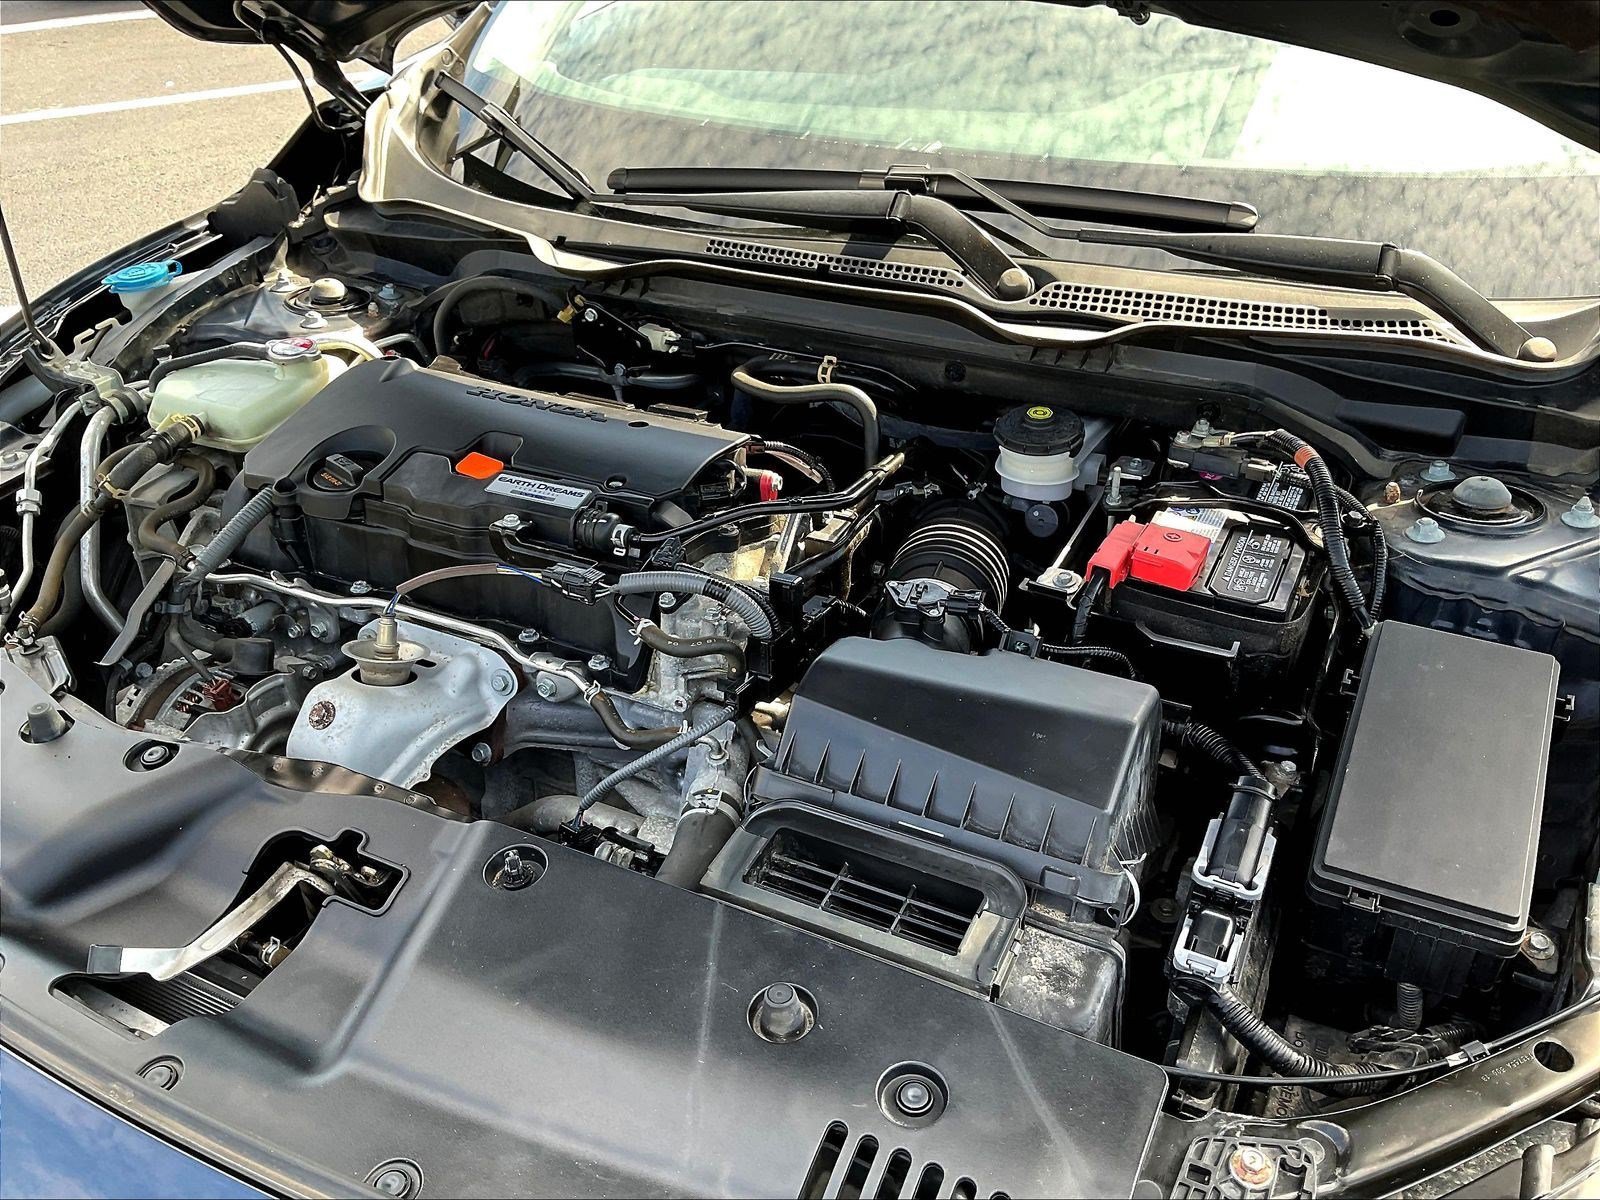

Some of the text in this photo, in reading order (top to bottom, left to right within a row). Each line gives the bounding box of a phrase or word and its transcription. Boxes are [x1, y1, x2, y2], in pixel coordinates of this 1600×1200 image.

[466, 387, 607, 422] HONDA
[498, 476, 536, 488] EARTH
[537, 483, 585, 498] DREAMS
[1224, 556, 1237, 577] DANGER
[1234, 536, 1247, 554] POISON
